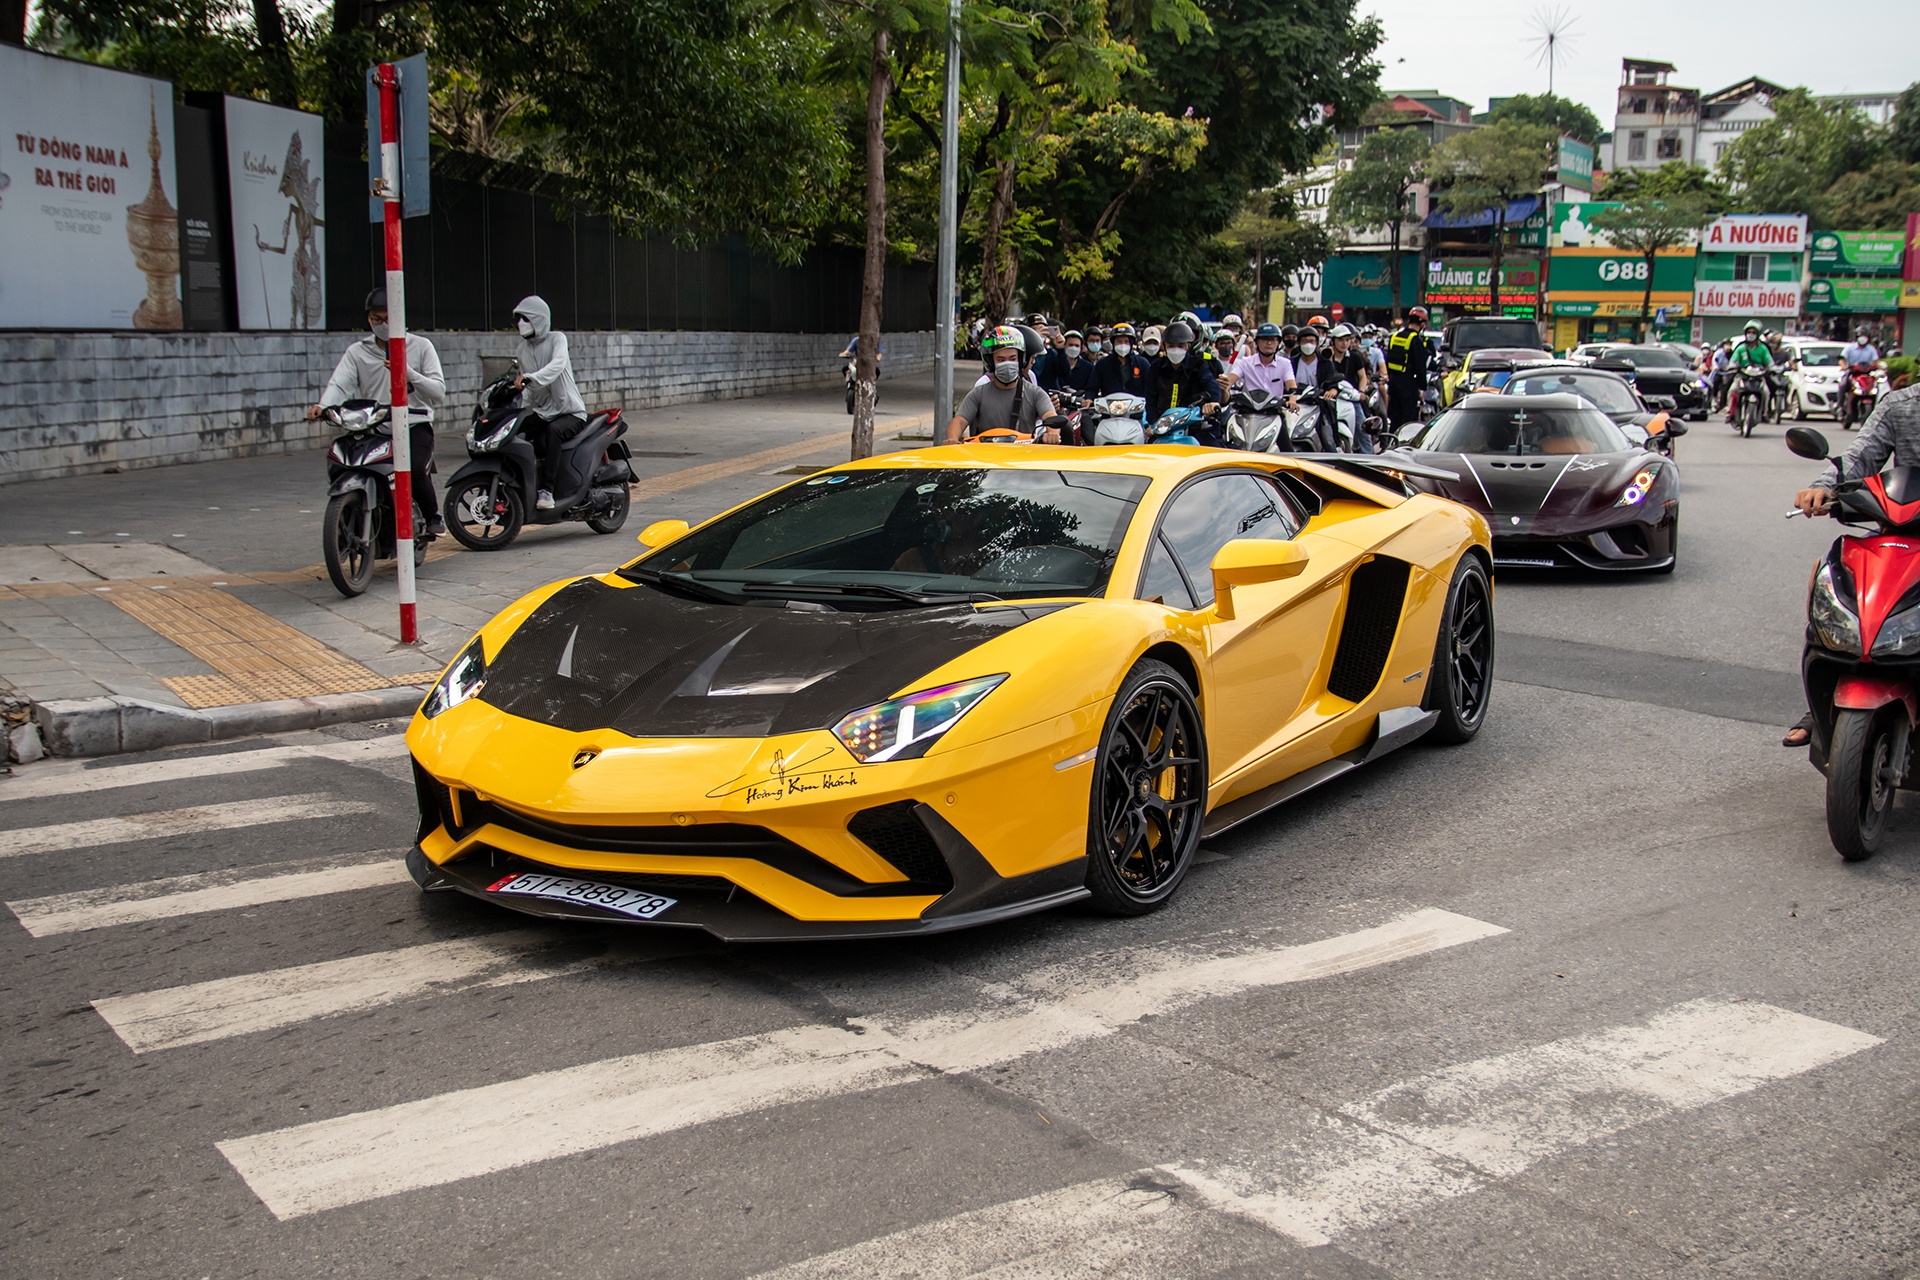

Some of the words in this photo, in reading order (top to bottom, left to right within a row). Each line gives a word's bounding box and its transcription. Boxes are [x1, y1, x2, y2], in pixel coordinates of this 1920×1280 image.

[16, 131, 35, 154] TỪ
[40, 136, 81, 161] ĐÔNG
[86, 145, 116, 167] NAM
[35, 167, 54, 187] RA
[57, 167, 82, 191] THẾ
[41, 204, 60, 216] FROM
[55, 220, 64, 231] TO
[65, 221, 77, 233] THE
[78, 223, 102, 235] WORLD
[1730, 221, 1799, 244] NƯỚNG
[1428, 267, 1474, 288] QUẢNG
[1507, 270, 1536, 286] LED
[1598, 259, 1649, 281] F88
[1728, 291, 1754, 308] CUA
[746, 788, 783, 804] Hoàng
[787, 777, 820, 795] Kim
[509, 874, 668, 914] 51F-889.78
